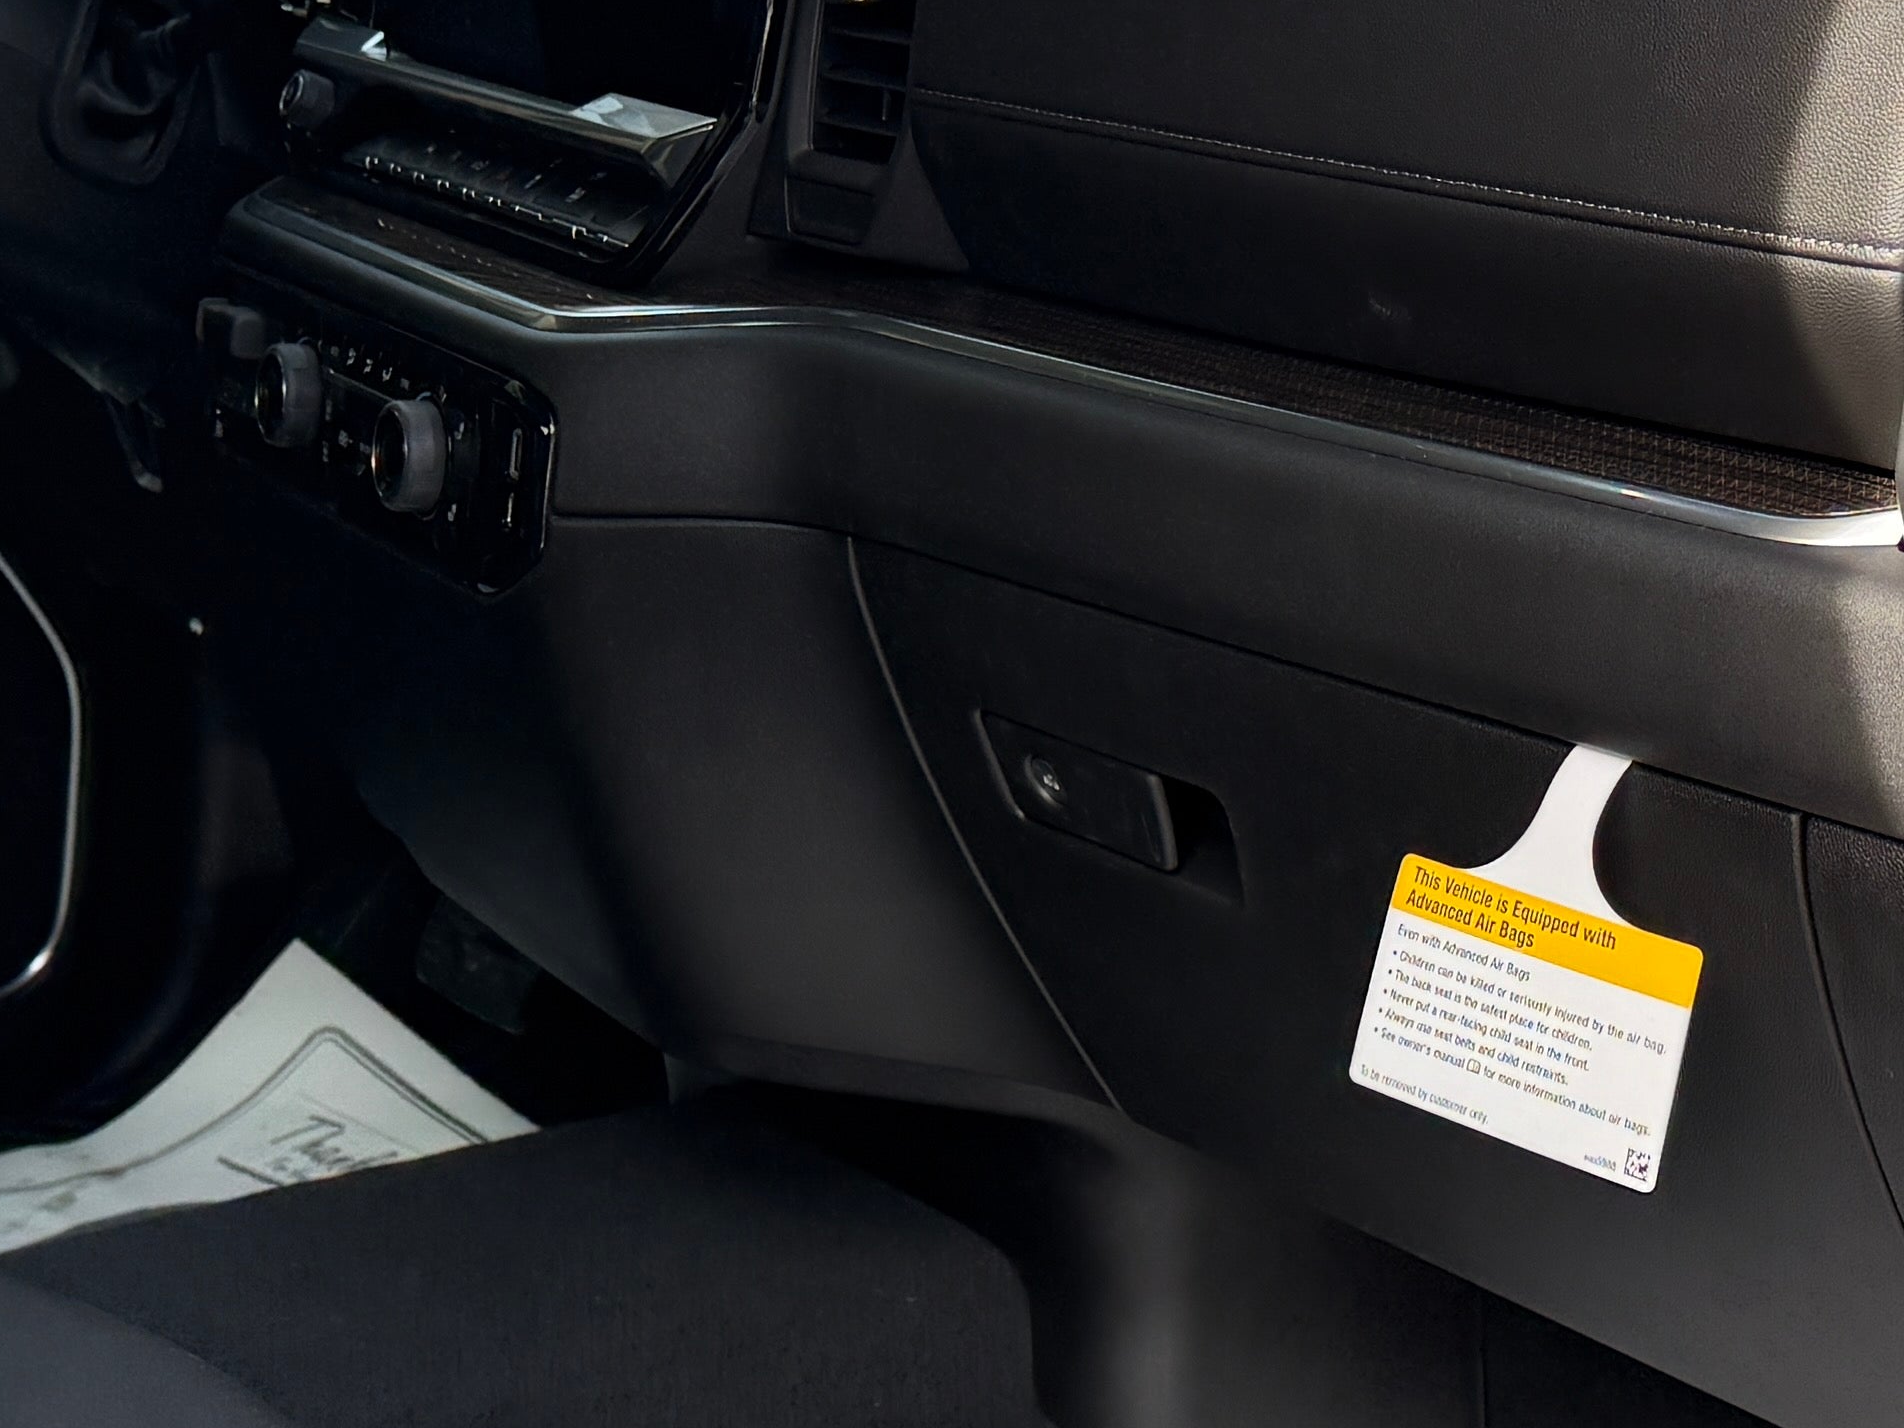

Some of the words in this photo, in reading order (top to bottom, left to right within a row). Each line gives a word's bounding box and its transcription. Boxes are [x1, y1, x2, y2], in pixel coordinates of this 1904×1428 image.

[1405, 888, 1474, 926] Advanced
[1474, 912, 1497, 935] Air
[1498, 919, 1535, 949] Bags
[1414, 865, 1442, 891] This
[1445, 875, 1493, 909] Vehicle
[1495, 893, 1509, 914] is
[1511, 899, 1580, 938] Equipped
[1583, 927, 1617, 951] with
[1643, 1035, 1666, 1056] bag.
